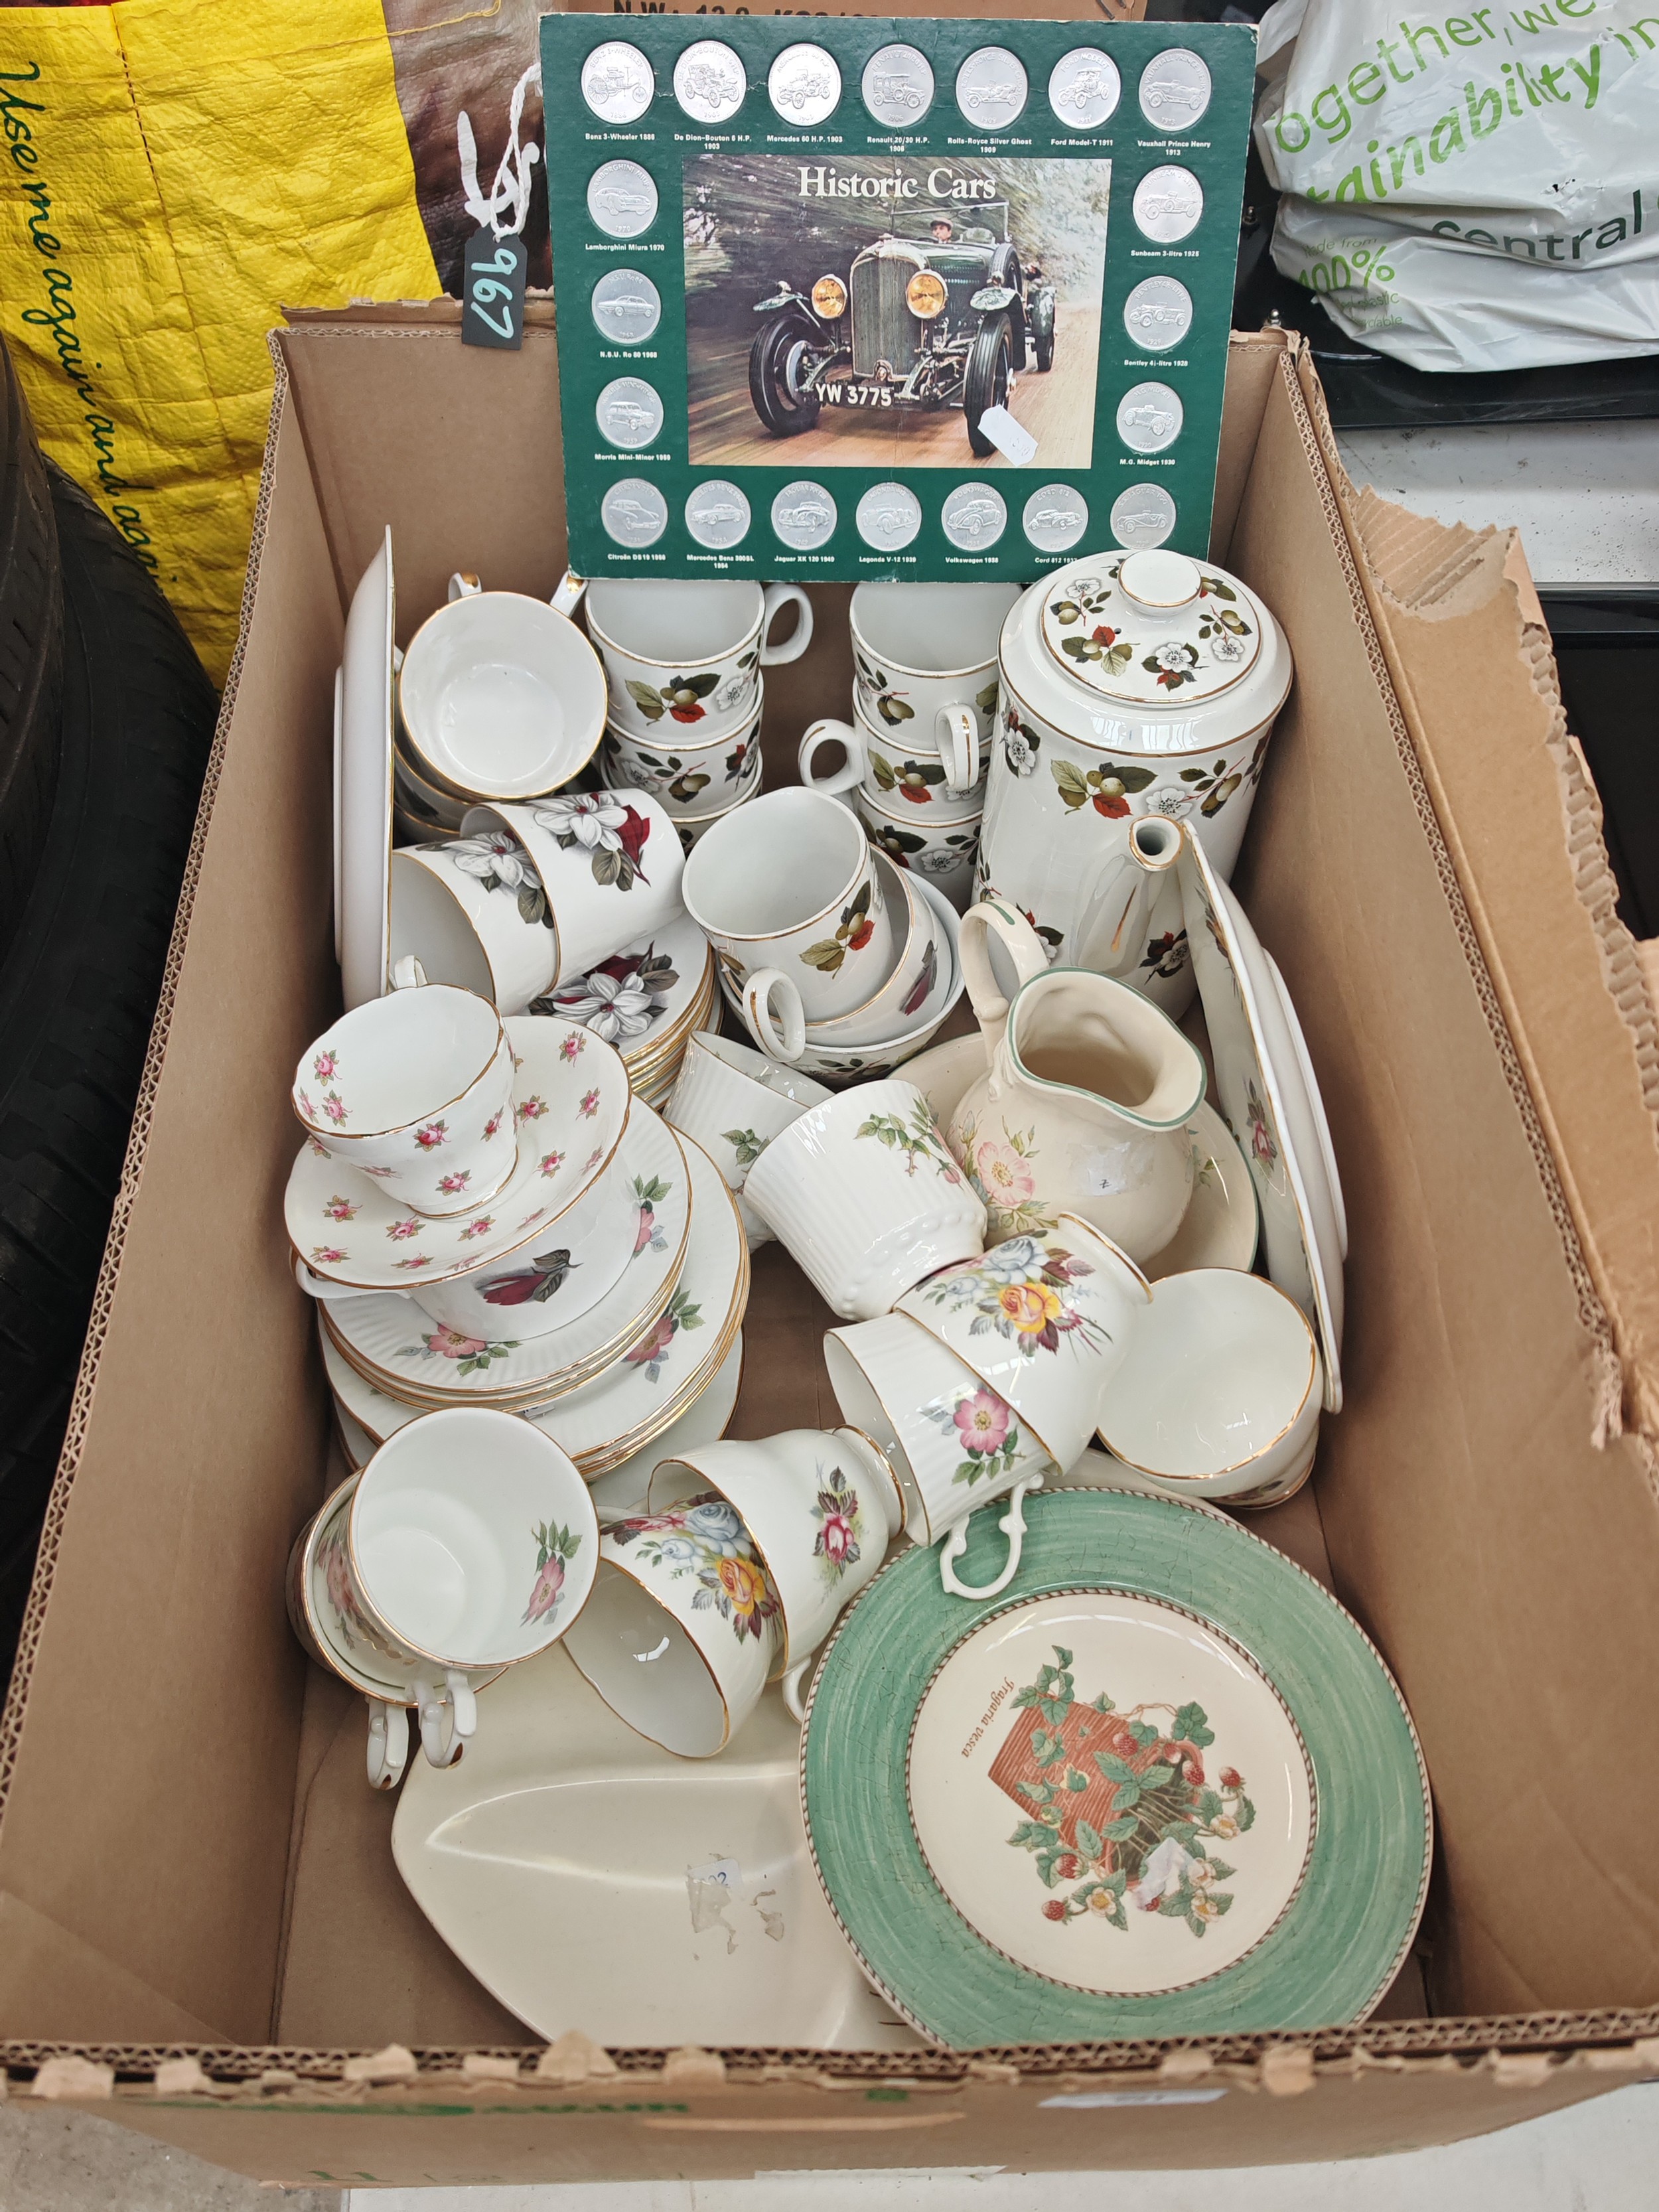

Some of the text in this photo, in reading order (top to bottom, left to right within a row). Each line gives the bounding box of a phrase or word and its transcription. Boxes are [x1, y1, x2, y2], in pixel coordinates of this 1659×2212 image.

[1269, 8, 1514, 153] ogether,
[867, 136, 894, 145] Renault
[894, 136, 914, 145] 20/30
[947, 137, 989, 145] Rolls-Royce
[1190, 140, 1211, 149] Henry
[797, 166, 996, 199] Historic Cars
[21, 182, 62, 259] me
[585, 243, 627, 252] Lamborghini
[471, 248, 518, 339] 967
[21, 268, 102, 407] again
[815, 383, 893, 407] YW 3775
[85, 413, 156, 497] and
[961, 1676, 1015, 1758] Fragaria vesca
